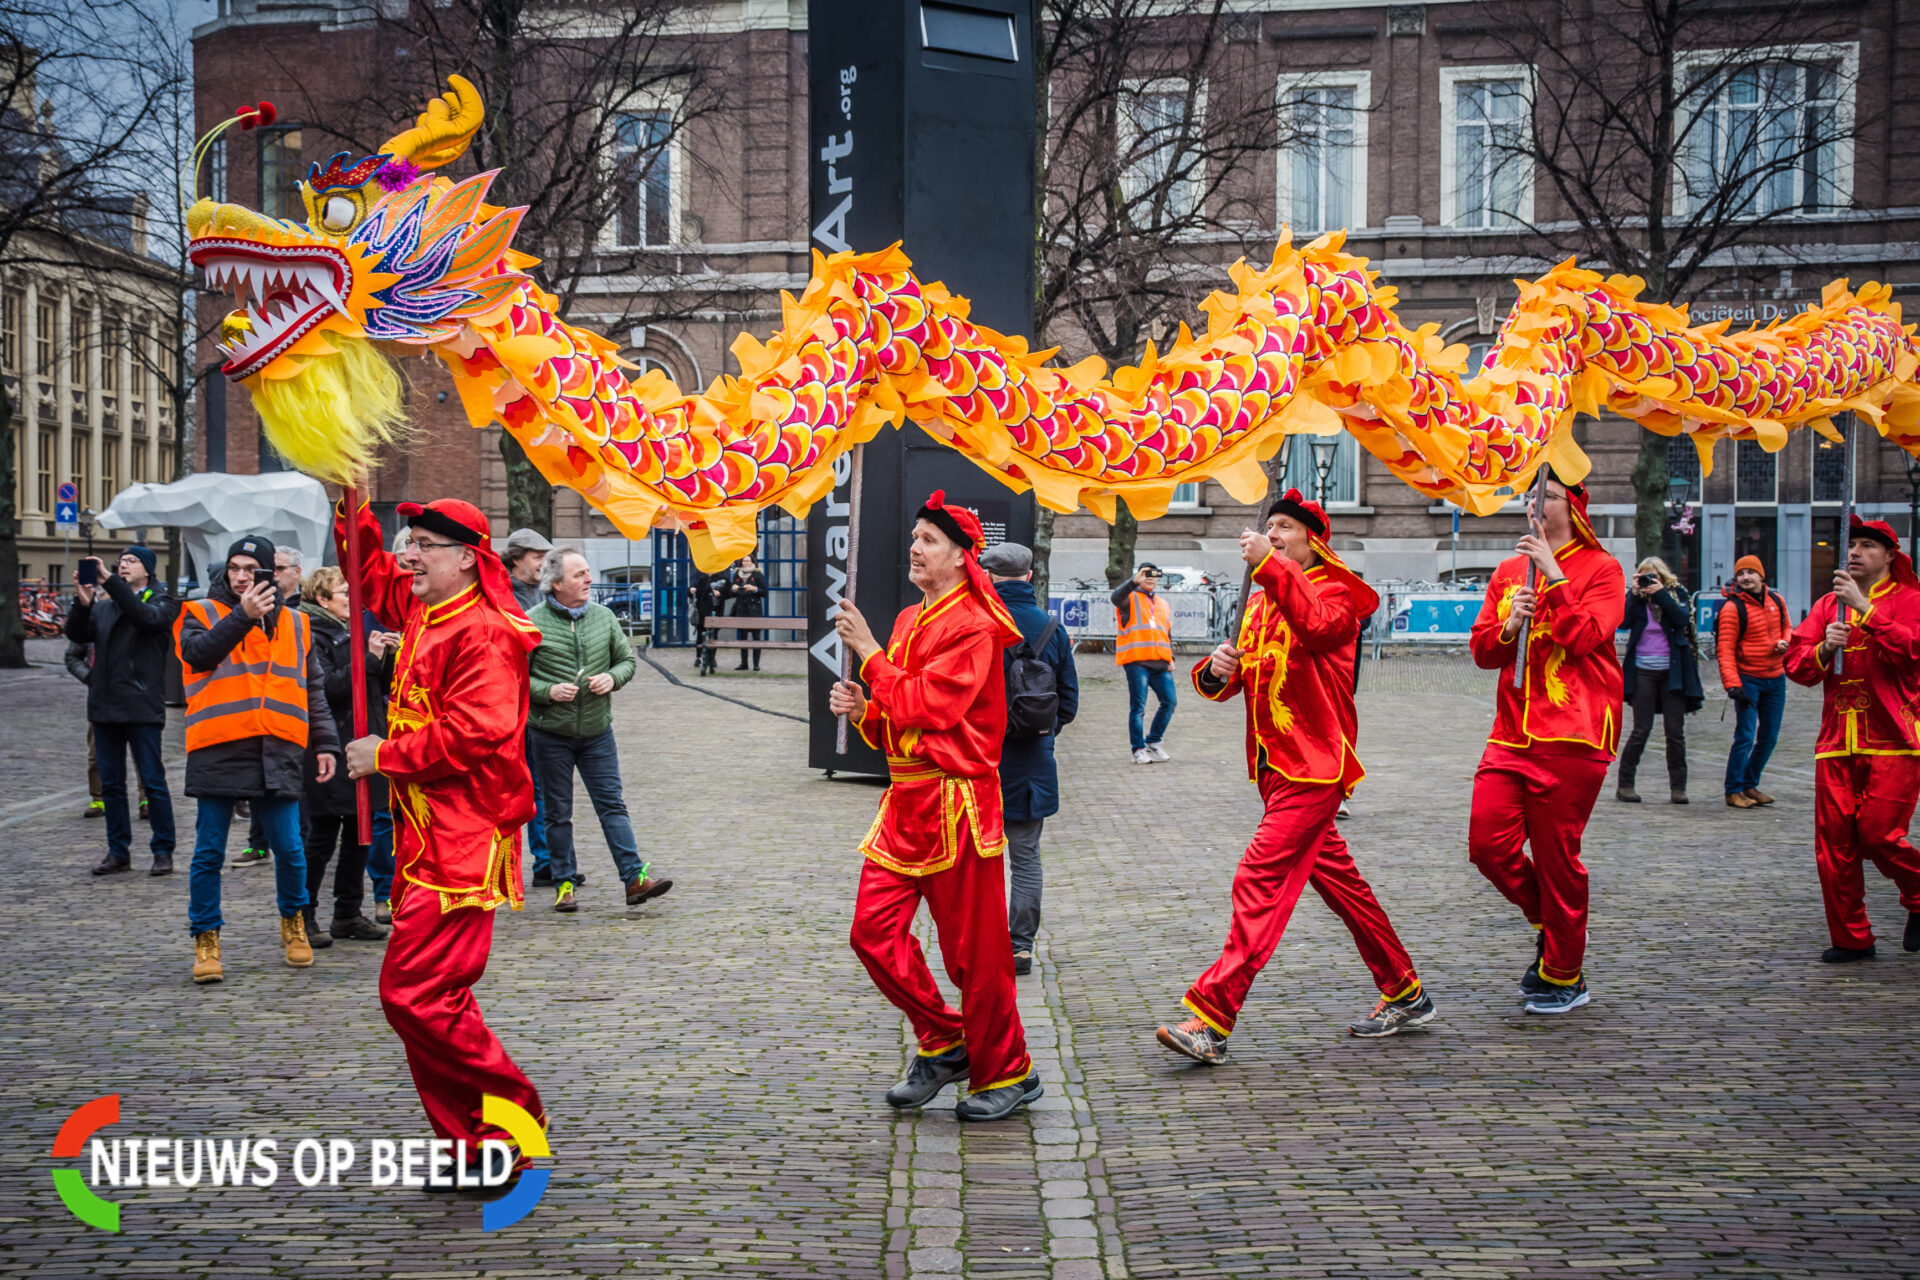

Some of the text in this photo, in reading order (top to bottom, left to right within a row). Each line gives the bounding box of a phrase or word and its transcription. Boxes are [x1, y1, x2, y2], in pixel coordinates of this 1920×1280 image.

[1690, 304, 1756, 321] ociëteit
[1762, 304, 1788, 320] De
[1700, 606, 1713, 625] P
